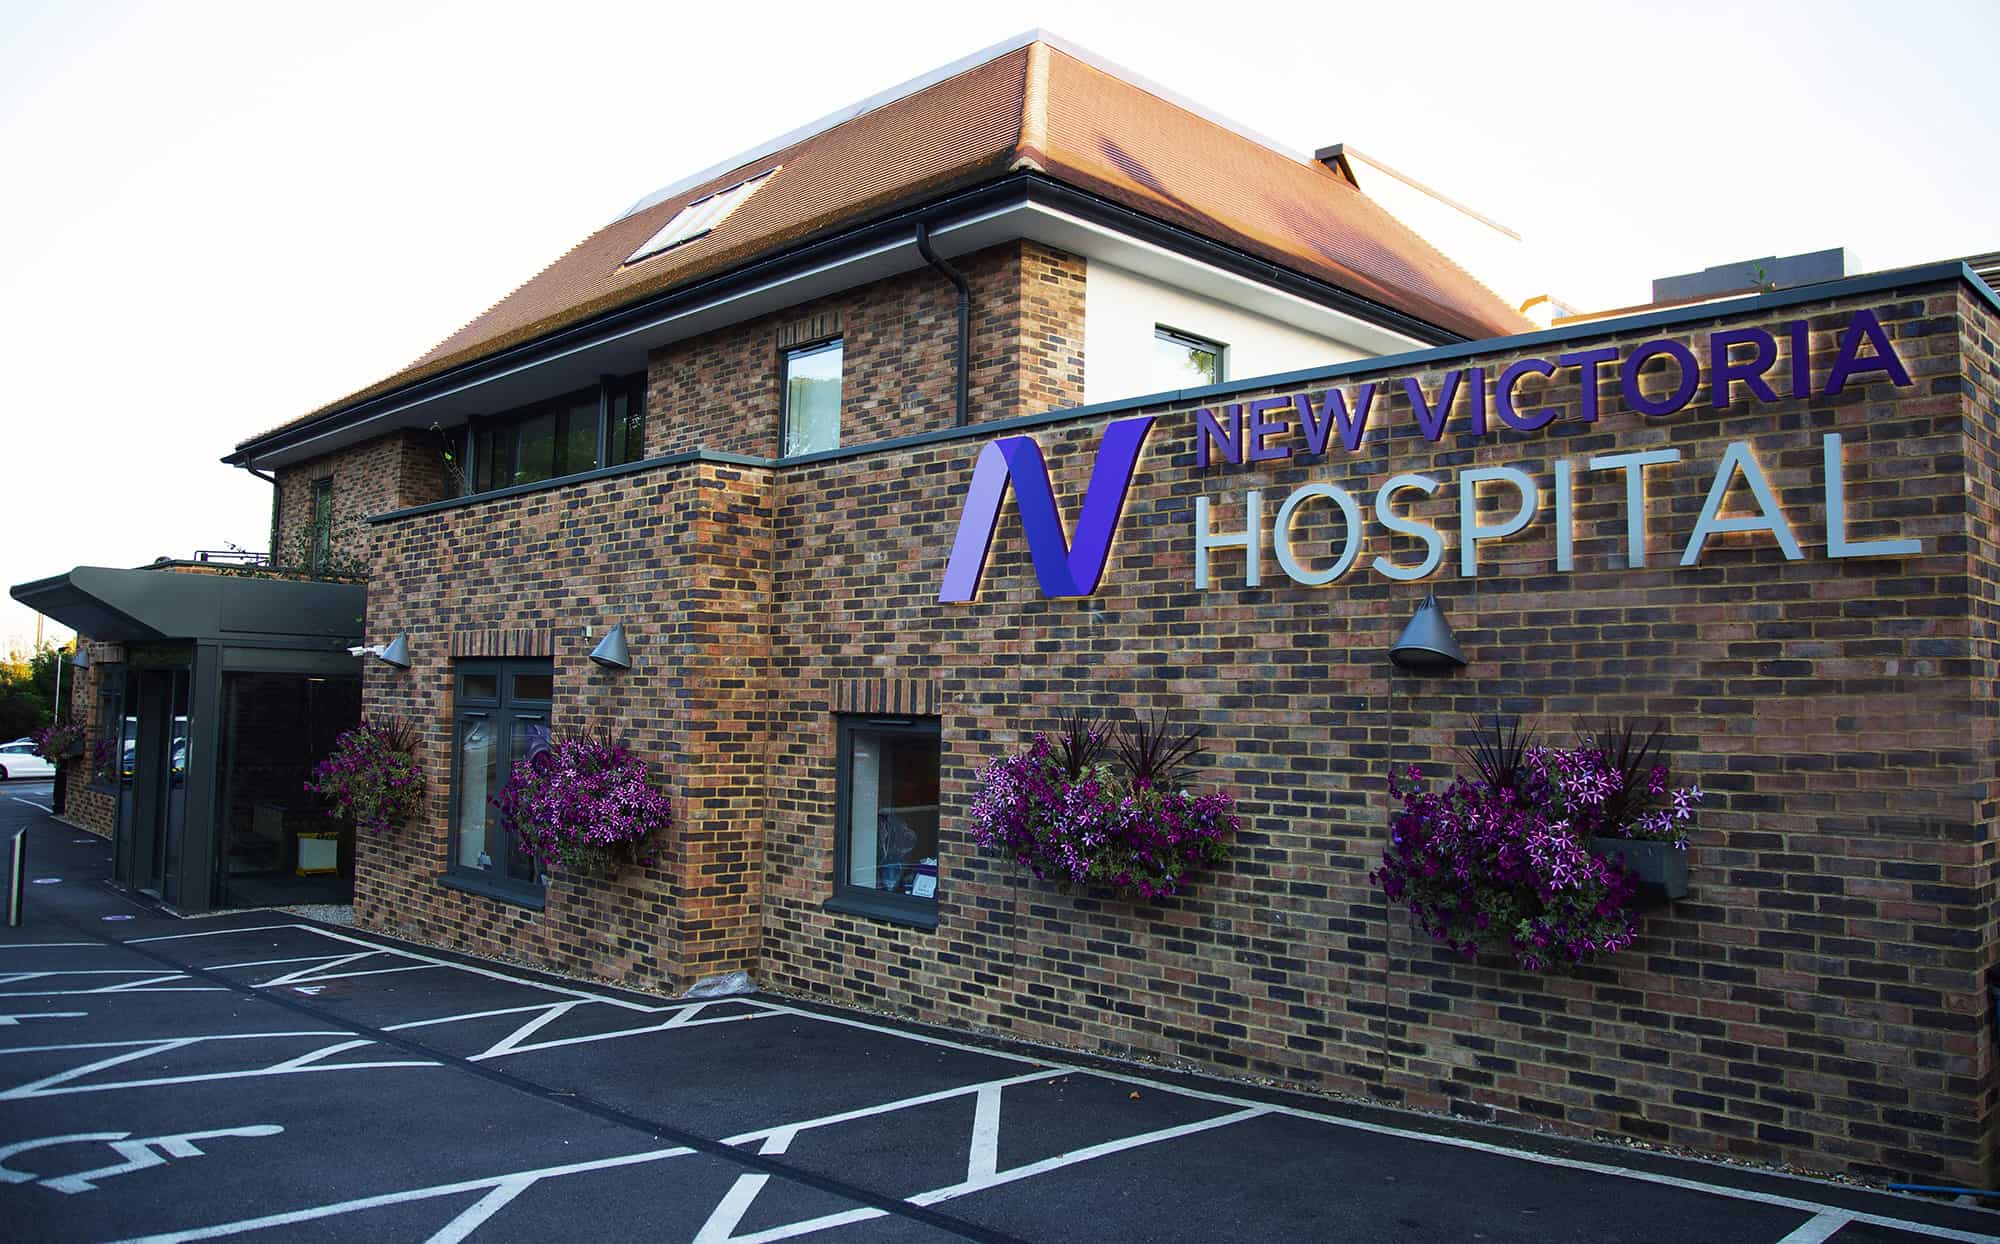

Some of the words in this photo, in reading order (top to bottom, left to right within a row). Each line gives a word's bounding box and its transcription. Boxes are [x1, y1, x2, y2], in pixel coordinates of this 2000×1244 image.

[1196, 383, 1378, 467] NEW
[1404, 309, 1913, 442] VICTORIA
[1194, 433, 1923, 589] HOSPITAL
